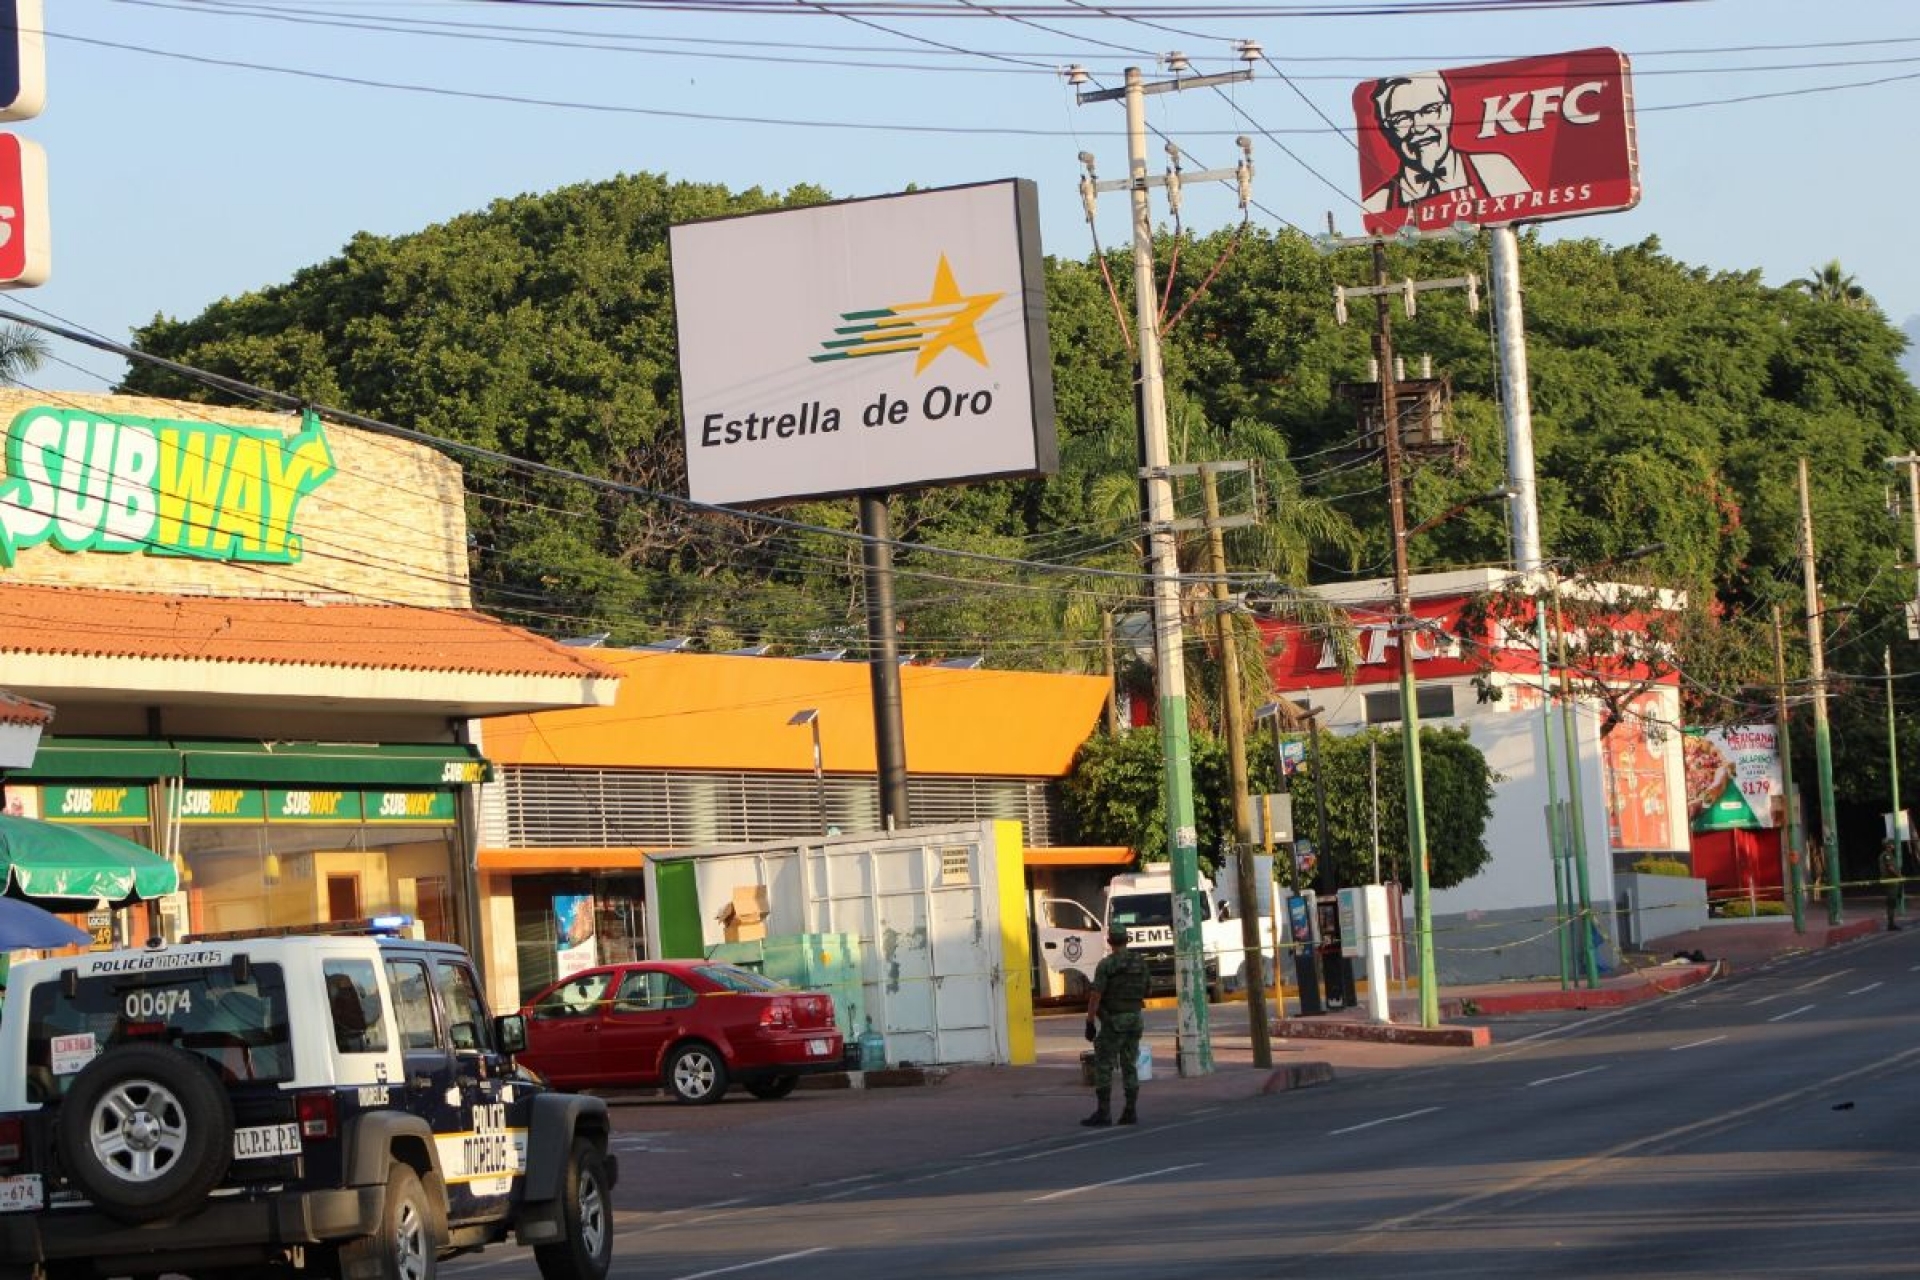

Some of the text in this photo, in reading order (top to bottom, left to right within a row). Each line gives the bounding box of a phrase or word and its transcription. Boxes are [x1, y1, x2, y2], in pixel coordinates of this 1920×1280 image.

[1477, 81, 1603, 140] KFC
[1405, 184, 1593, 223] AUTOEXPRESS
[701, 384, 993, 447] Estrella de Oro
[0, 414, 334, 557] SUBWAY
[62, 788, 127, 814] SUBWAY
[1742, 781, 1770, 794] $179
[182, 789, 243, 814] SUBWAY
[282, 790, 343, 815] SUBWAY
[380, 792, 436, 816] SUBWAY
[126, 989, 191, 1018] 00674
